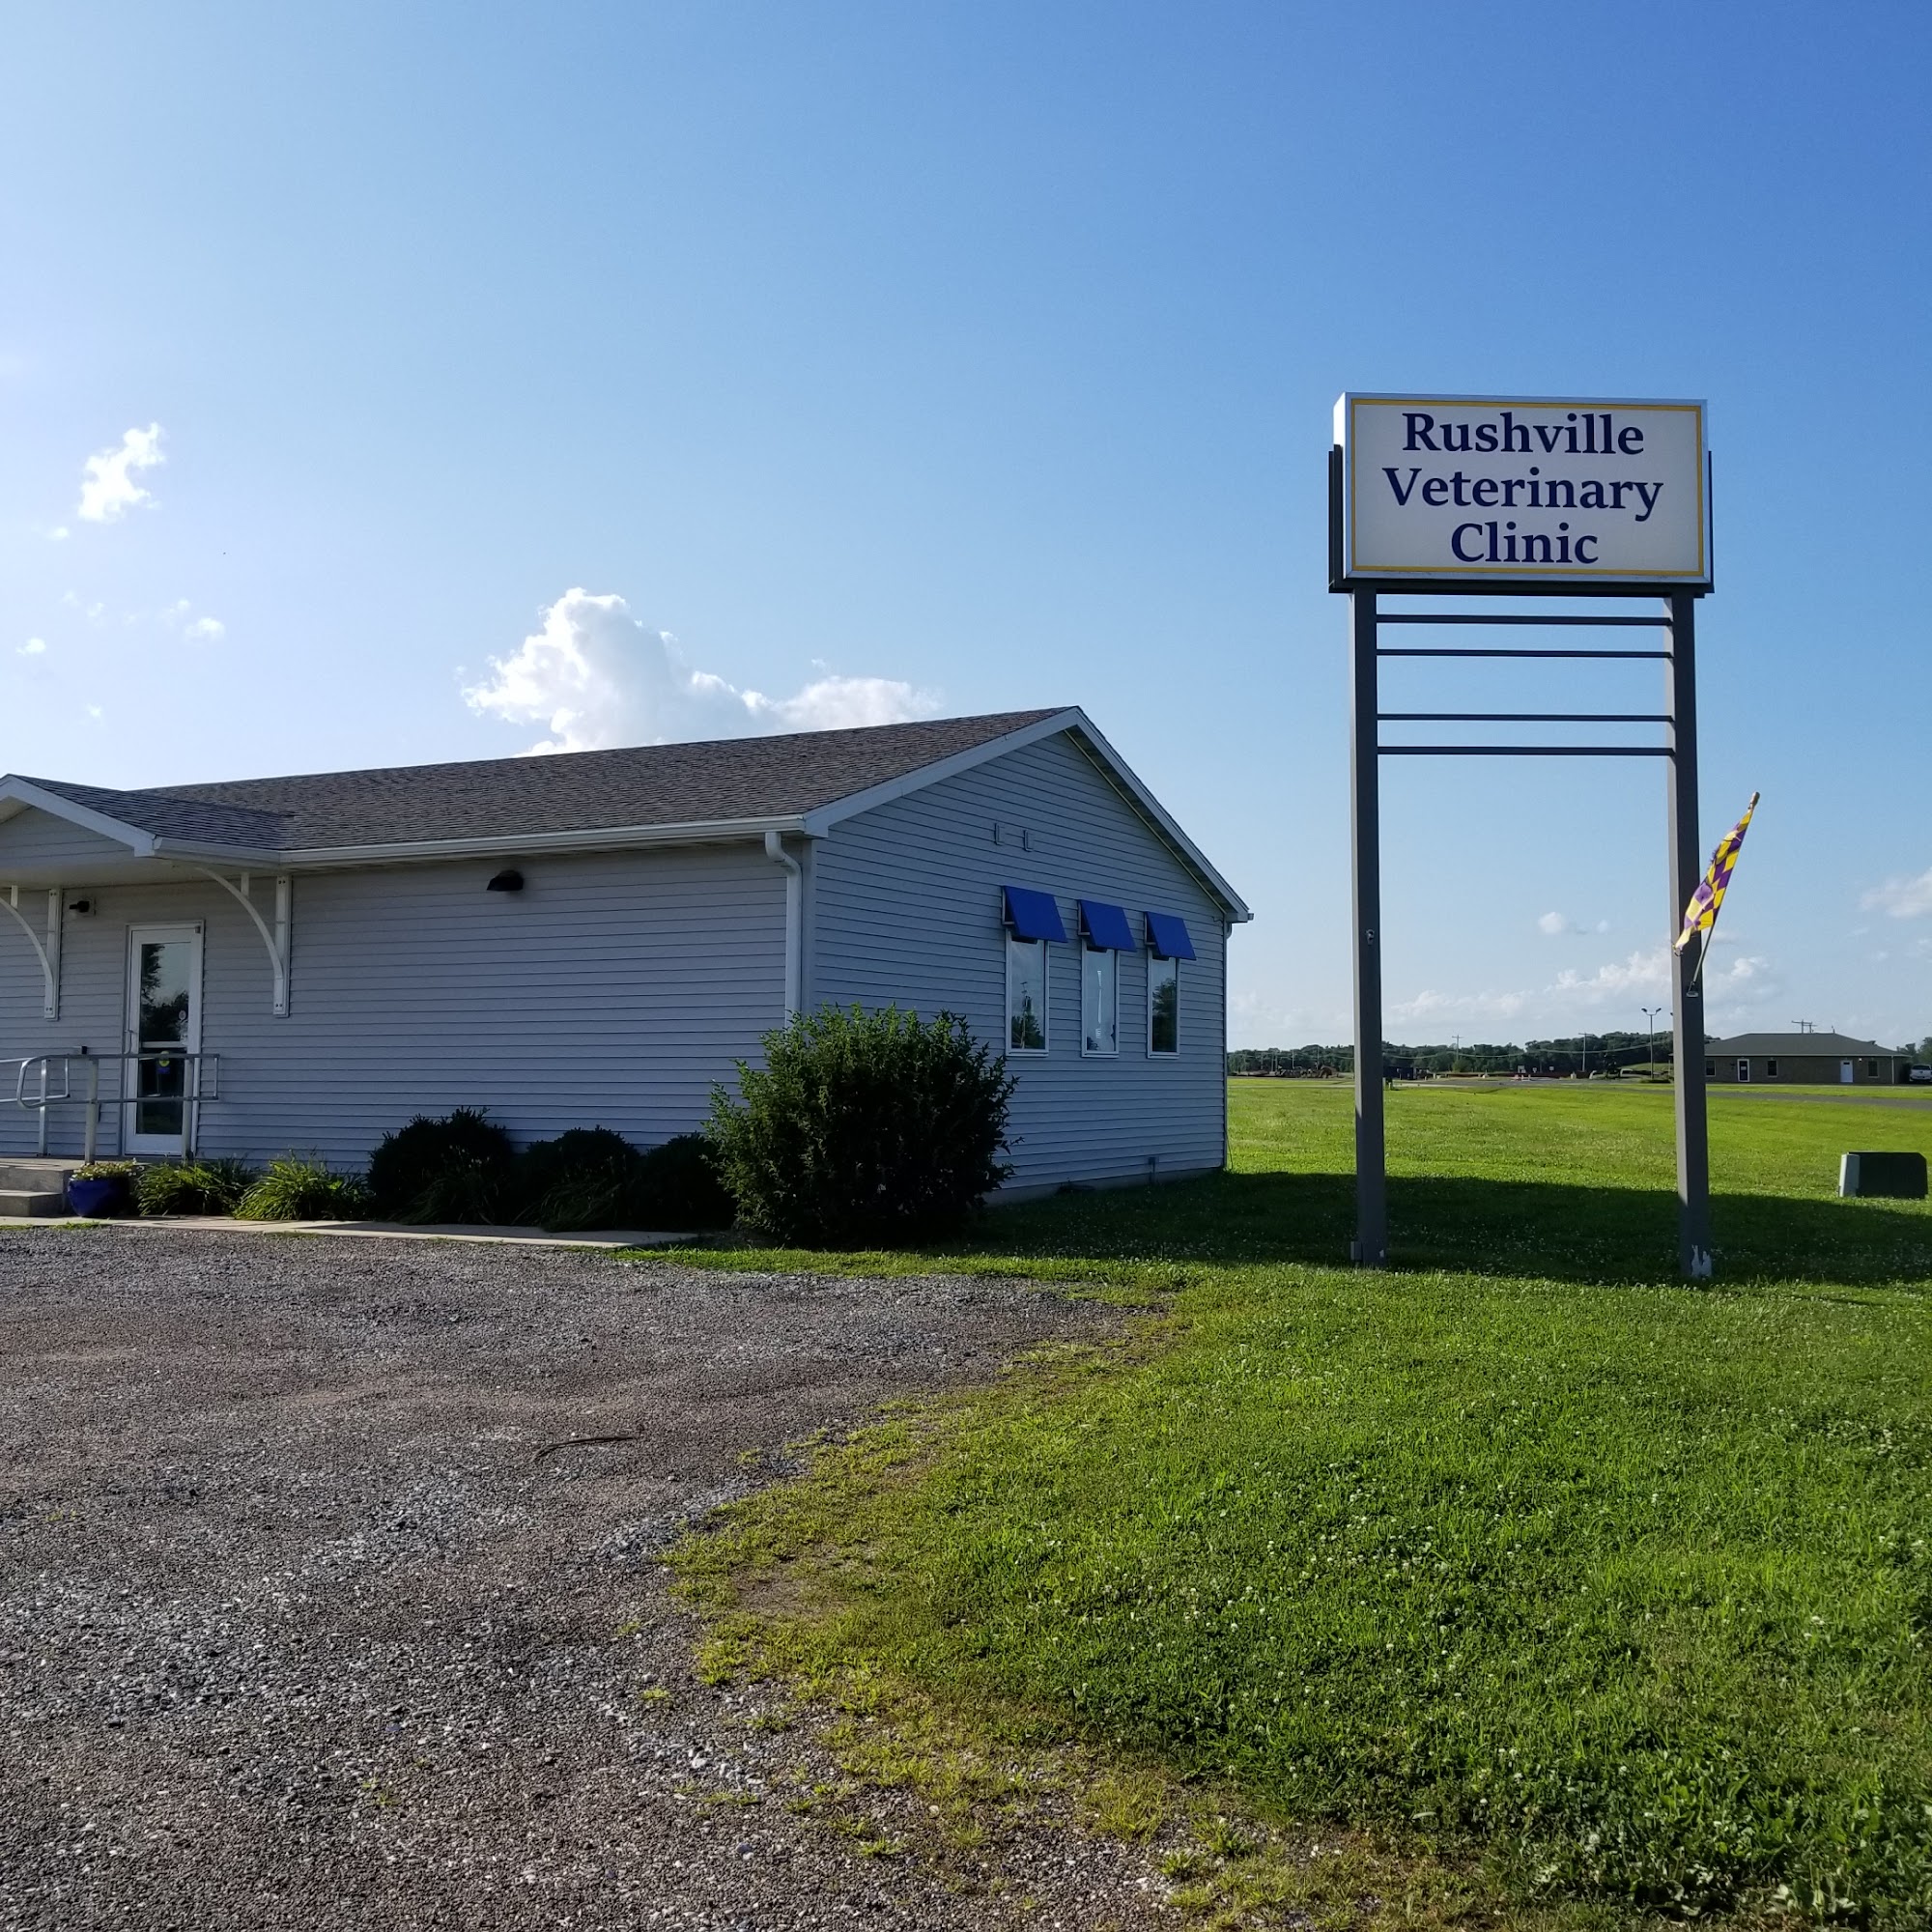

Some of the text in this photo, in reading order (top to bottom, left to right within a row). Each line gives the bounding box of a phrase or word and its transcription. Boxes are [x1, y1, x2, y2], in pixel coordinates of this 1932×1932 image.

[1402, 412, 1644, 455] Rushville
[1381, 467, 1663, 522] Veterinary
[1451, 522, 1599, 564] Clinic
